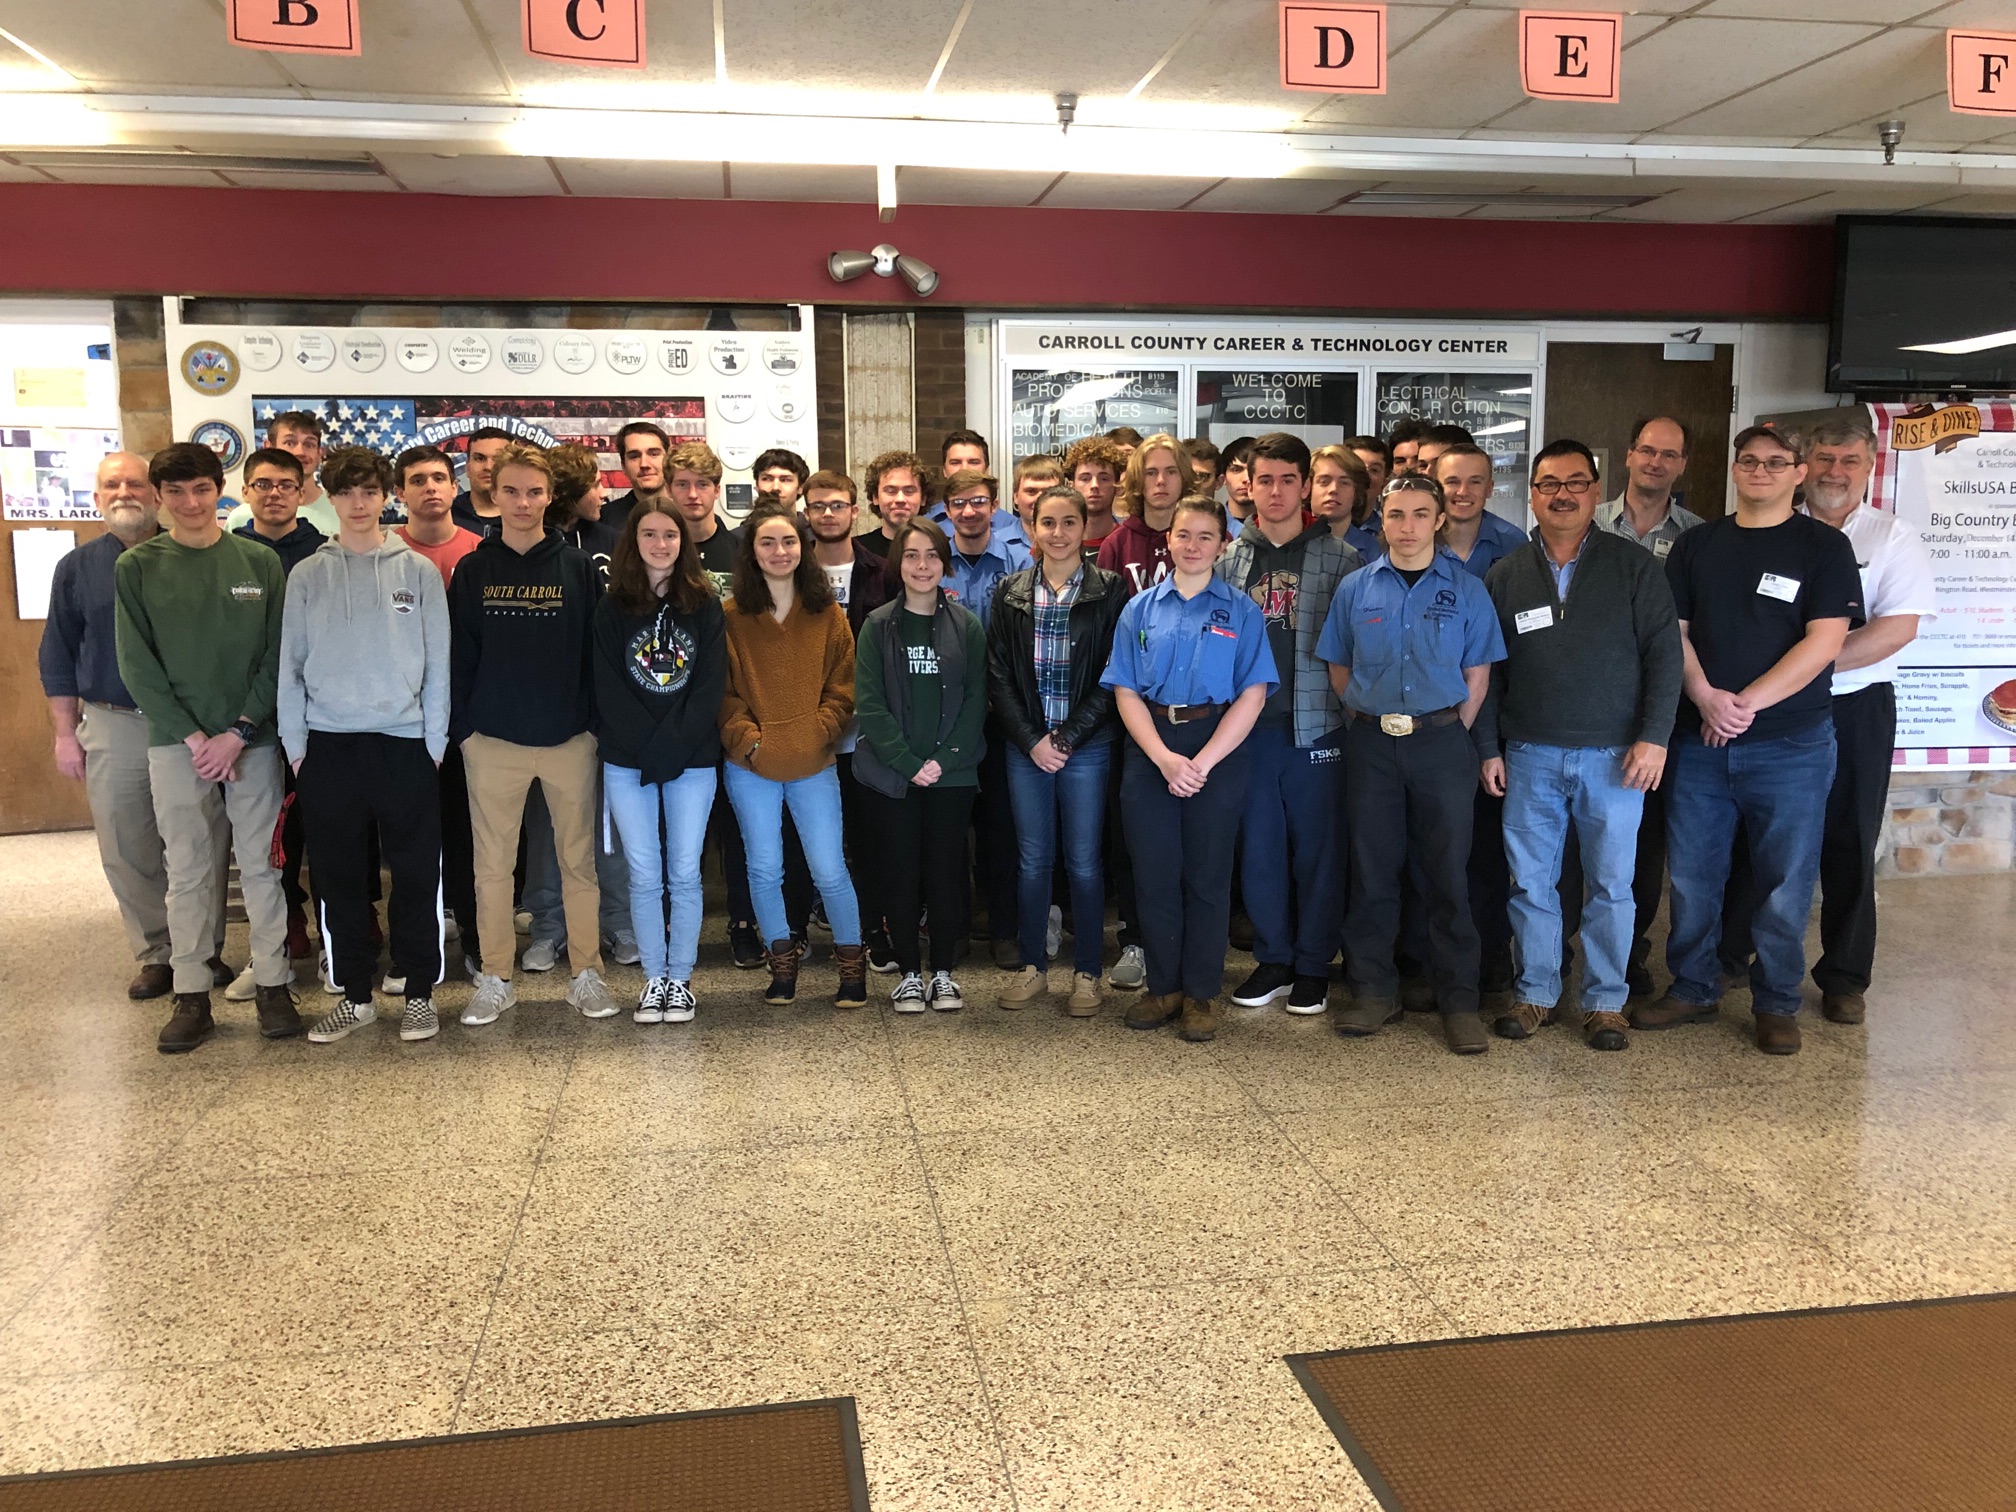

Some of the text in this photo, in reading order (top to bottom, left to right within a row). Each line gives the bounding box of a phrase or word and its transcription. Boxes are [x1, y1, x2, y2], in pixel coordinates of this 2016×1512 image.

[272, 0, 319, 26] B
[565, 0, 606, 41] C
[1313, 26, 1355, 69] D
[1553, 35, 1589, 78] E
[1977, 53, 2009, 94] F
[452, 346, 487, 354] Welding
[1038, 335, 1508, 353] CARROLL COUNTY CAREER & TECHNOLOGY CENTER
[518, 352, 537, 364] DLLR
[621, 355, 641, 364] PLTW
[667, 348, 675, 368] PRINT
[674, 348, 688, 368] ED
[1015, 372, 1058, 381] ACADEMY
[1064, 373, 1077, 382] OF
[1232, 374, 1322, 388] WELCOME
[1144, 387, 1166, 395] PORT
[1262, 388, 1286, 402] TO
[1063, 404, 1141, 418] SERVICES
[1244, 404, 1306, 418] CCCTC
[424, 417, 476, 444] Career
[478, 415, 508, 432] and
[1013, 423, 1108, 437] BIOMEDICAL
[1895, 411, 1978, 445] RISE & DINE!
[1944, 480, 2006, 494] SkillsUSA
[10, 509, 53, 518] MRS.
[1931, 513, 1951, 530] Big
[1955, 513, 2009, 530] Country
[1920, 532, 1966, 545] Saturday,
[1930, 549, 1950, 559] 7:00
[1965, 549, 1990, 559] 11:00
[1991, 551, 2012, 559] a.m.
[392, 592, 415, 604] VANS
[482, 585, 563, 599] SOUTH CARROLL
[630, 665, 646, 686] STATE
[1310, 748, 1334, 760] FSK
